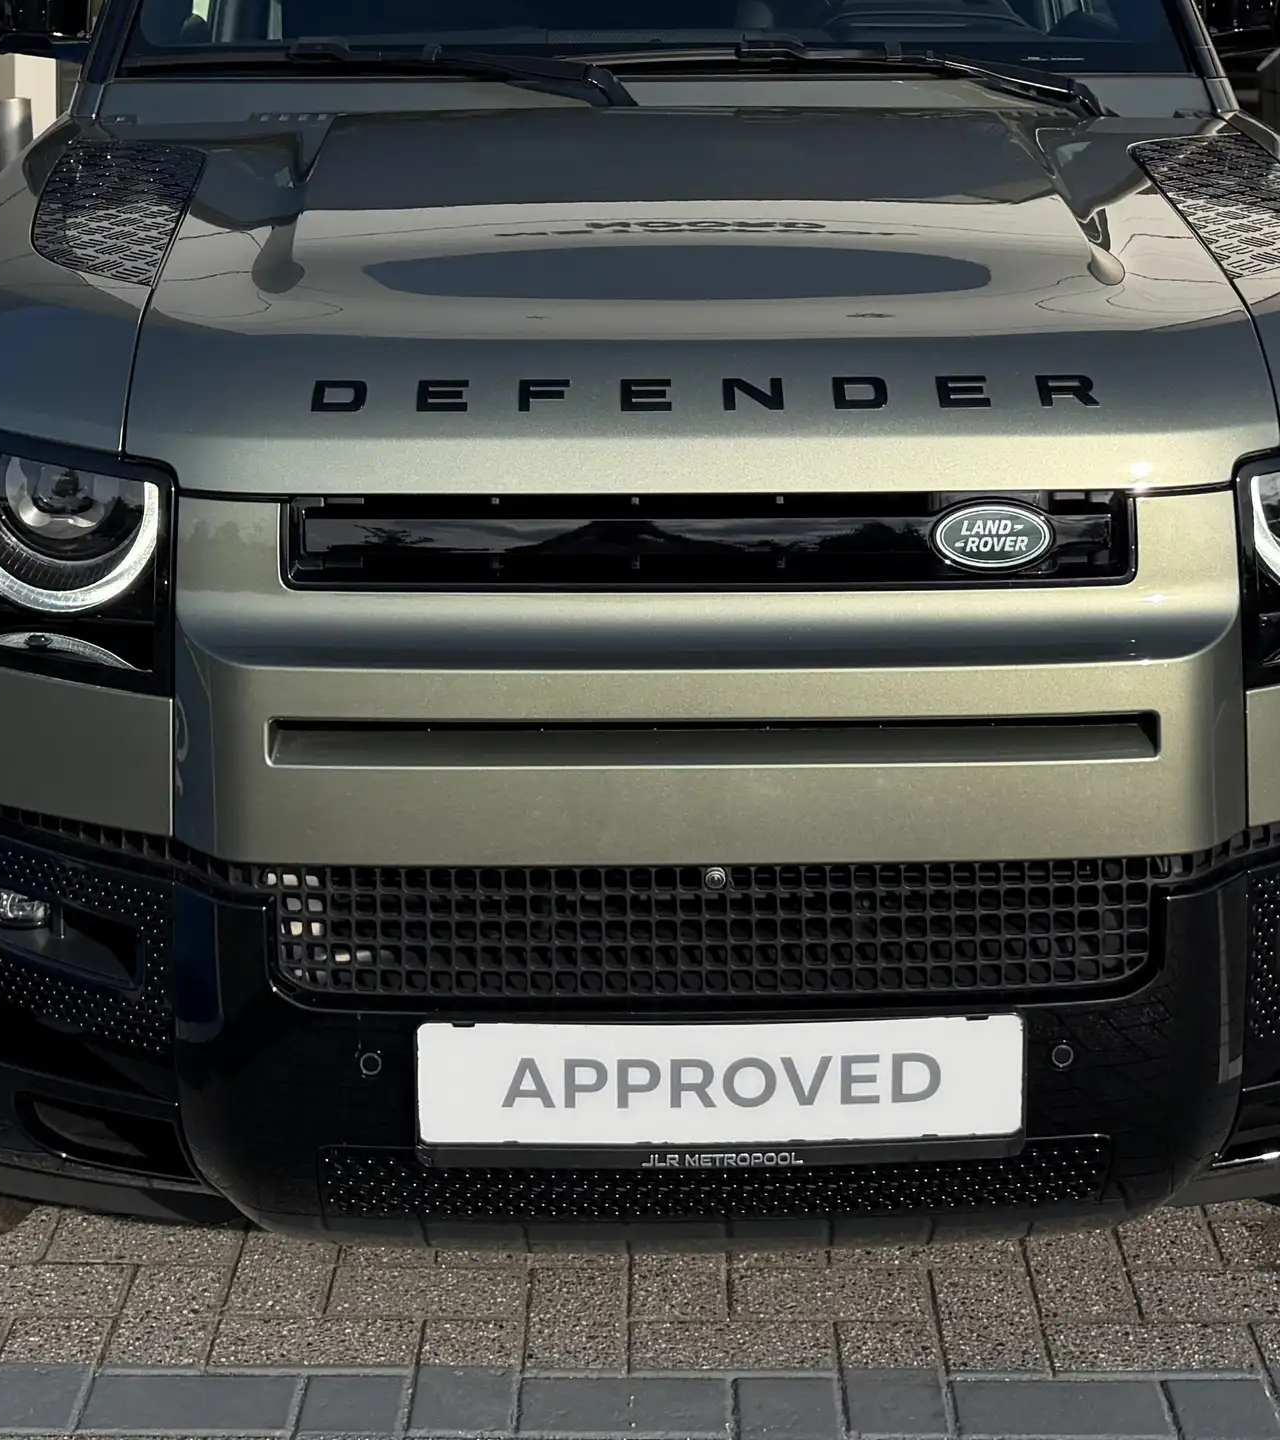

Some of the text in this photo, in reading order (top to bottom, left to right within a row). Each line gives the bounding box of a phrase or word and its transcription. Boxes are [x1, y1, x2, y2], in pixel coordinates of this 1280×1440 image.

[310, 373, 1101, 413] DEFENDER
[960, 519, 1012, 536] LAND
[964, 536, 1029, 553] ROVER
[501, 1051, 942, 1109] APPROVED
[641, 1152, 804, 1167] JLR METROPOOL
